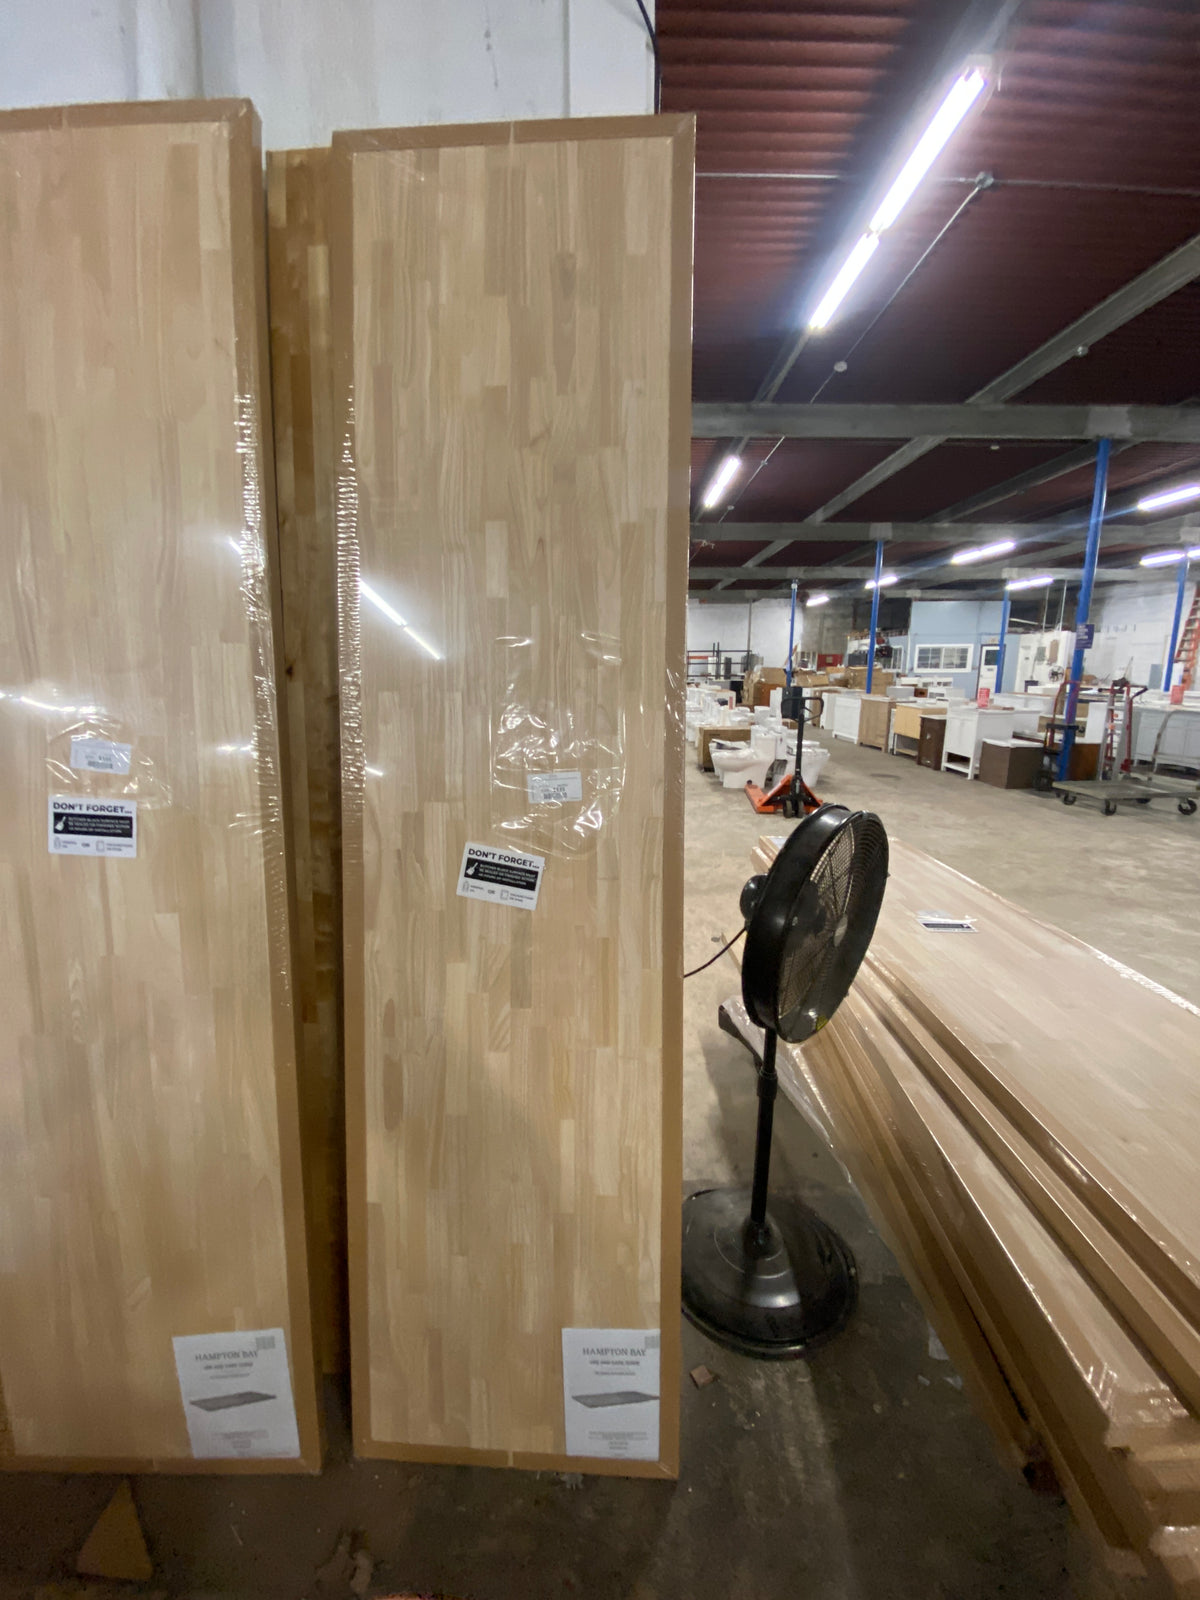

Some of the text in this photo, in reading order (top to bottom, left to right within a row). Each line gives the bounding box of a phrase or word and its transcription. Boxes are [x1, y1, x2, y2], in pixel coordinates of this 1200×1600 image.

[53, 802, 83, 811] DON'T
[468, 848, 497, 860] DON'T
[583, 1347, 646, 1357] HAMPTON BAY
